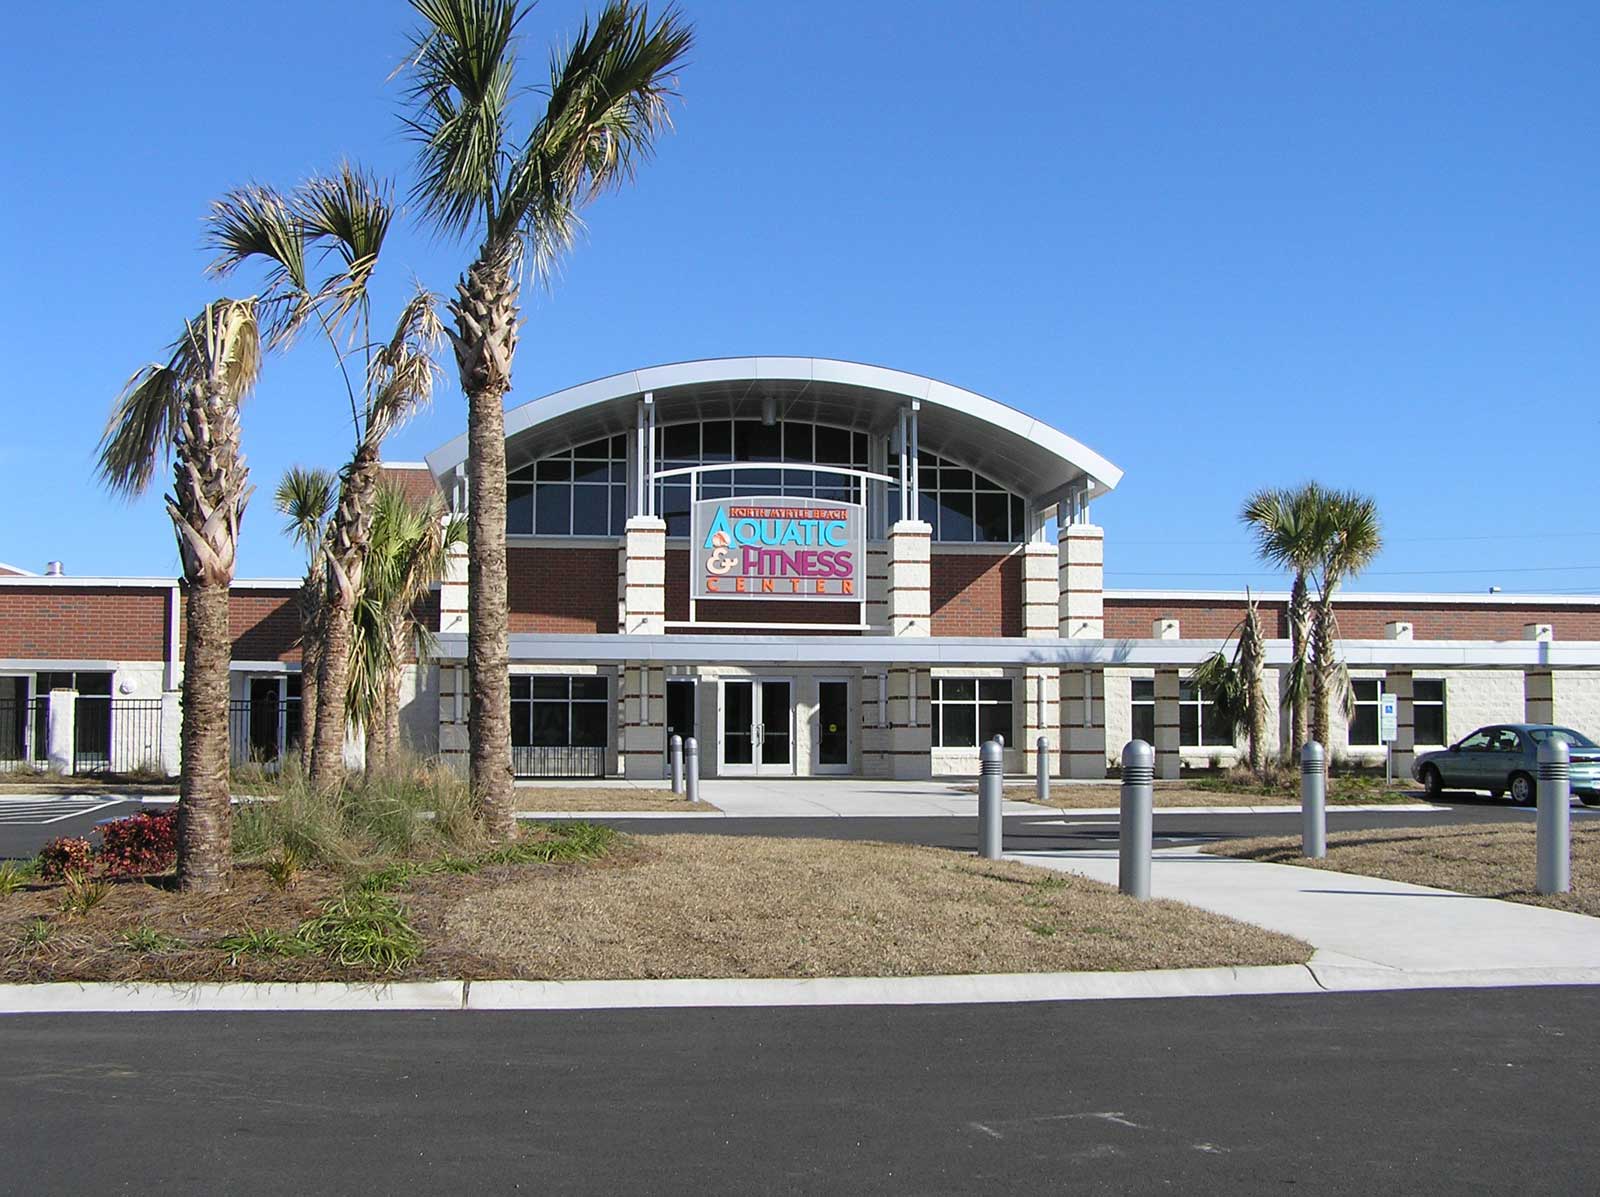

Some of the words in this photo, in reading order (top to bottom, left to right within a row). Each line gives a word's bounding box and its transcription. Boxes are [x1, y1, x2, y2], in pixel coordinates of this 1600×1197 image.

[730, 507, 766, 519] NORTH
[768, 508, 809, 520] MYRTLE
[813, 508, 848, 520] BEACH
[704, 505, 849, 549] AQUATIC
[706, 547, 738, 576] &
[740, 545, 853, 577] FITNESS
[706, 577, 853, 594] CENTER
